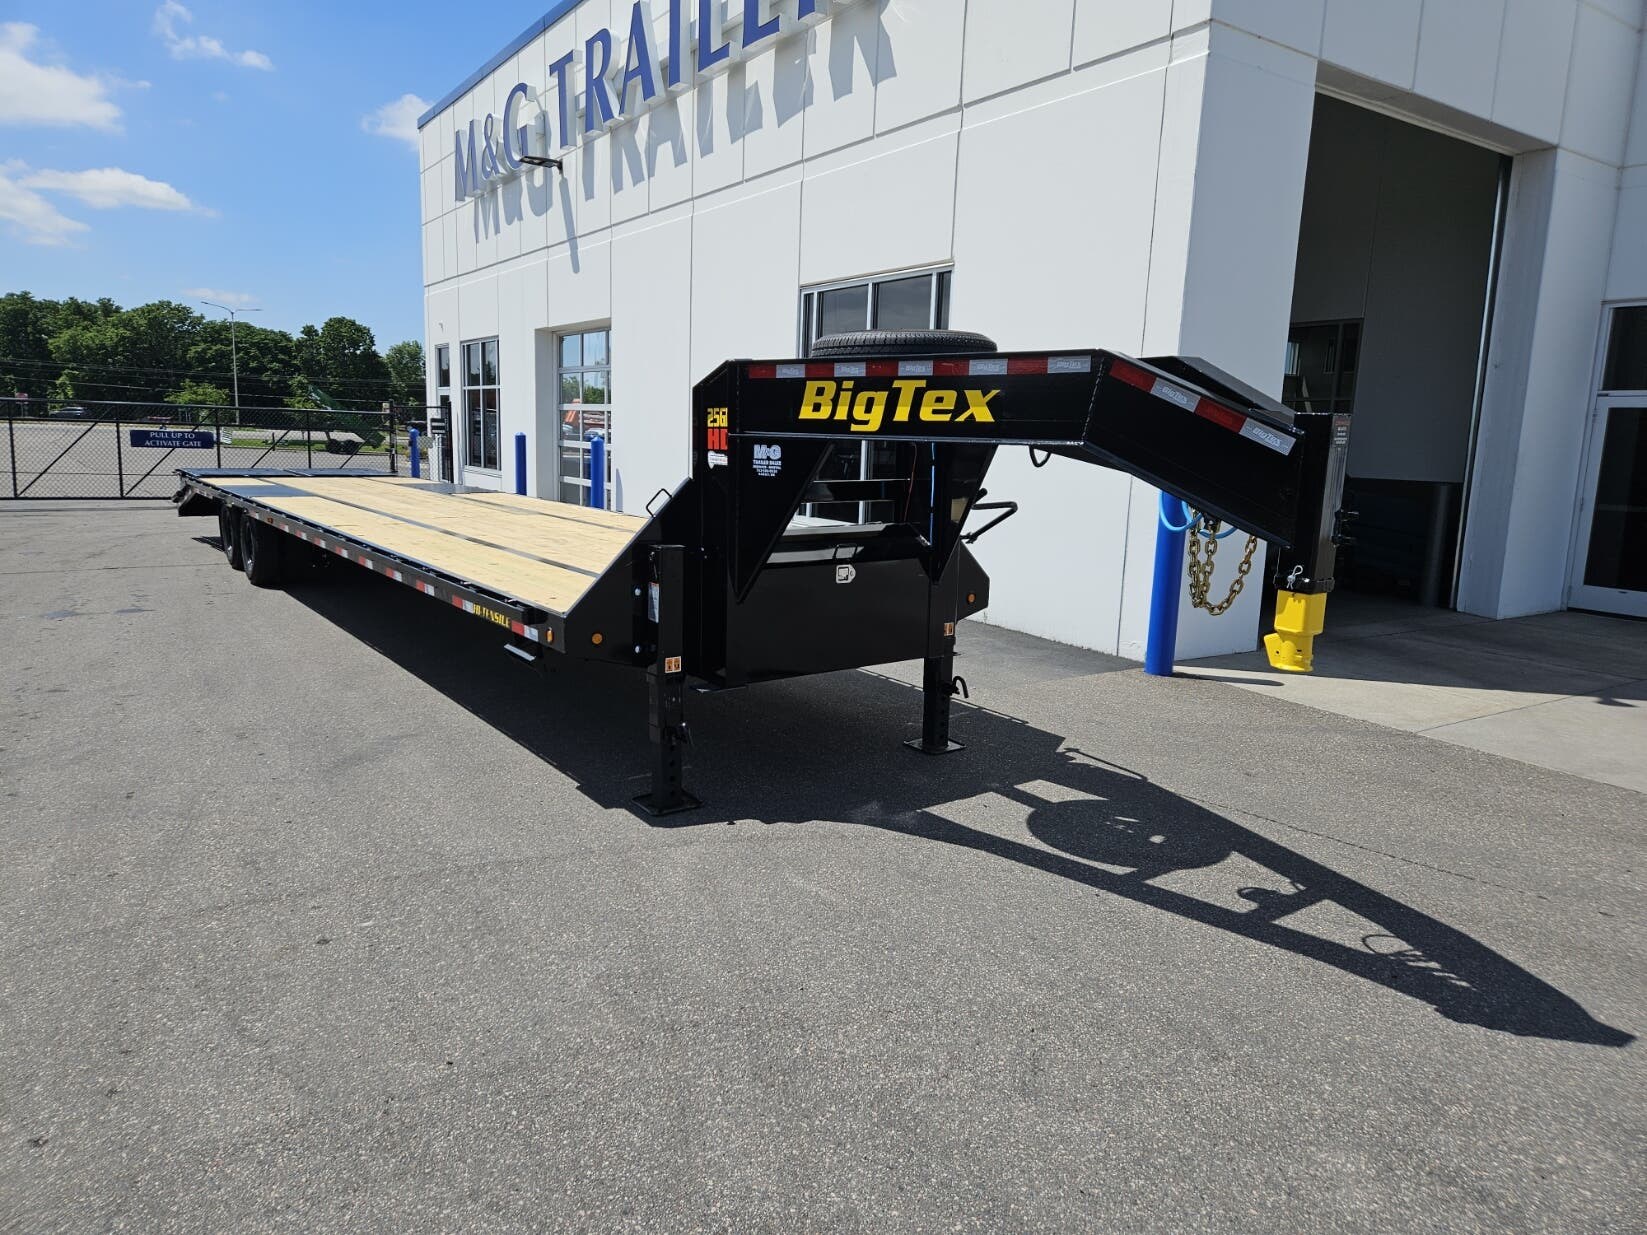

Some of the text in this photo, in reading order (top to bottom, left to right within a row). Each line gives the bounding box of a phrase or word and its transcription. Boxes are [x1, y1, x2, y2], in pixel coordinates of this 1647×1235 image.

[455, 0, 816, 200] M&G TRAIL
[799, 379, 1001, 432] BigTex
[144, 439, 181, 447] ACTIVATE
